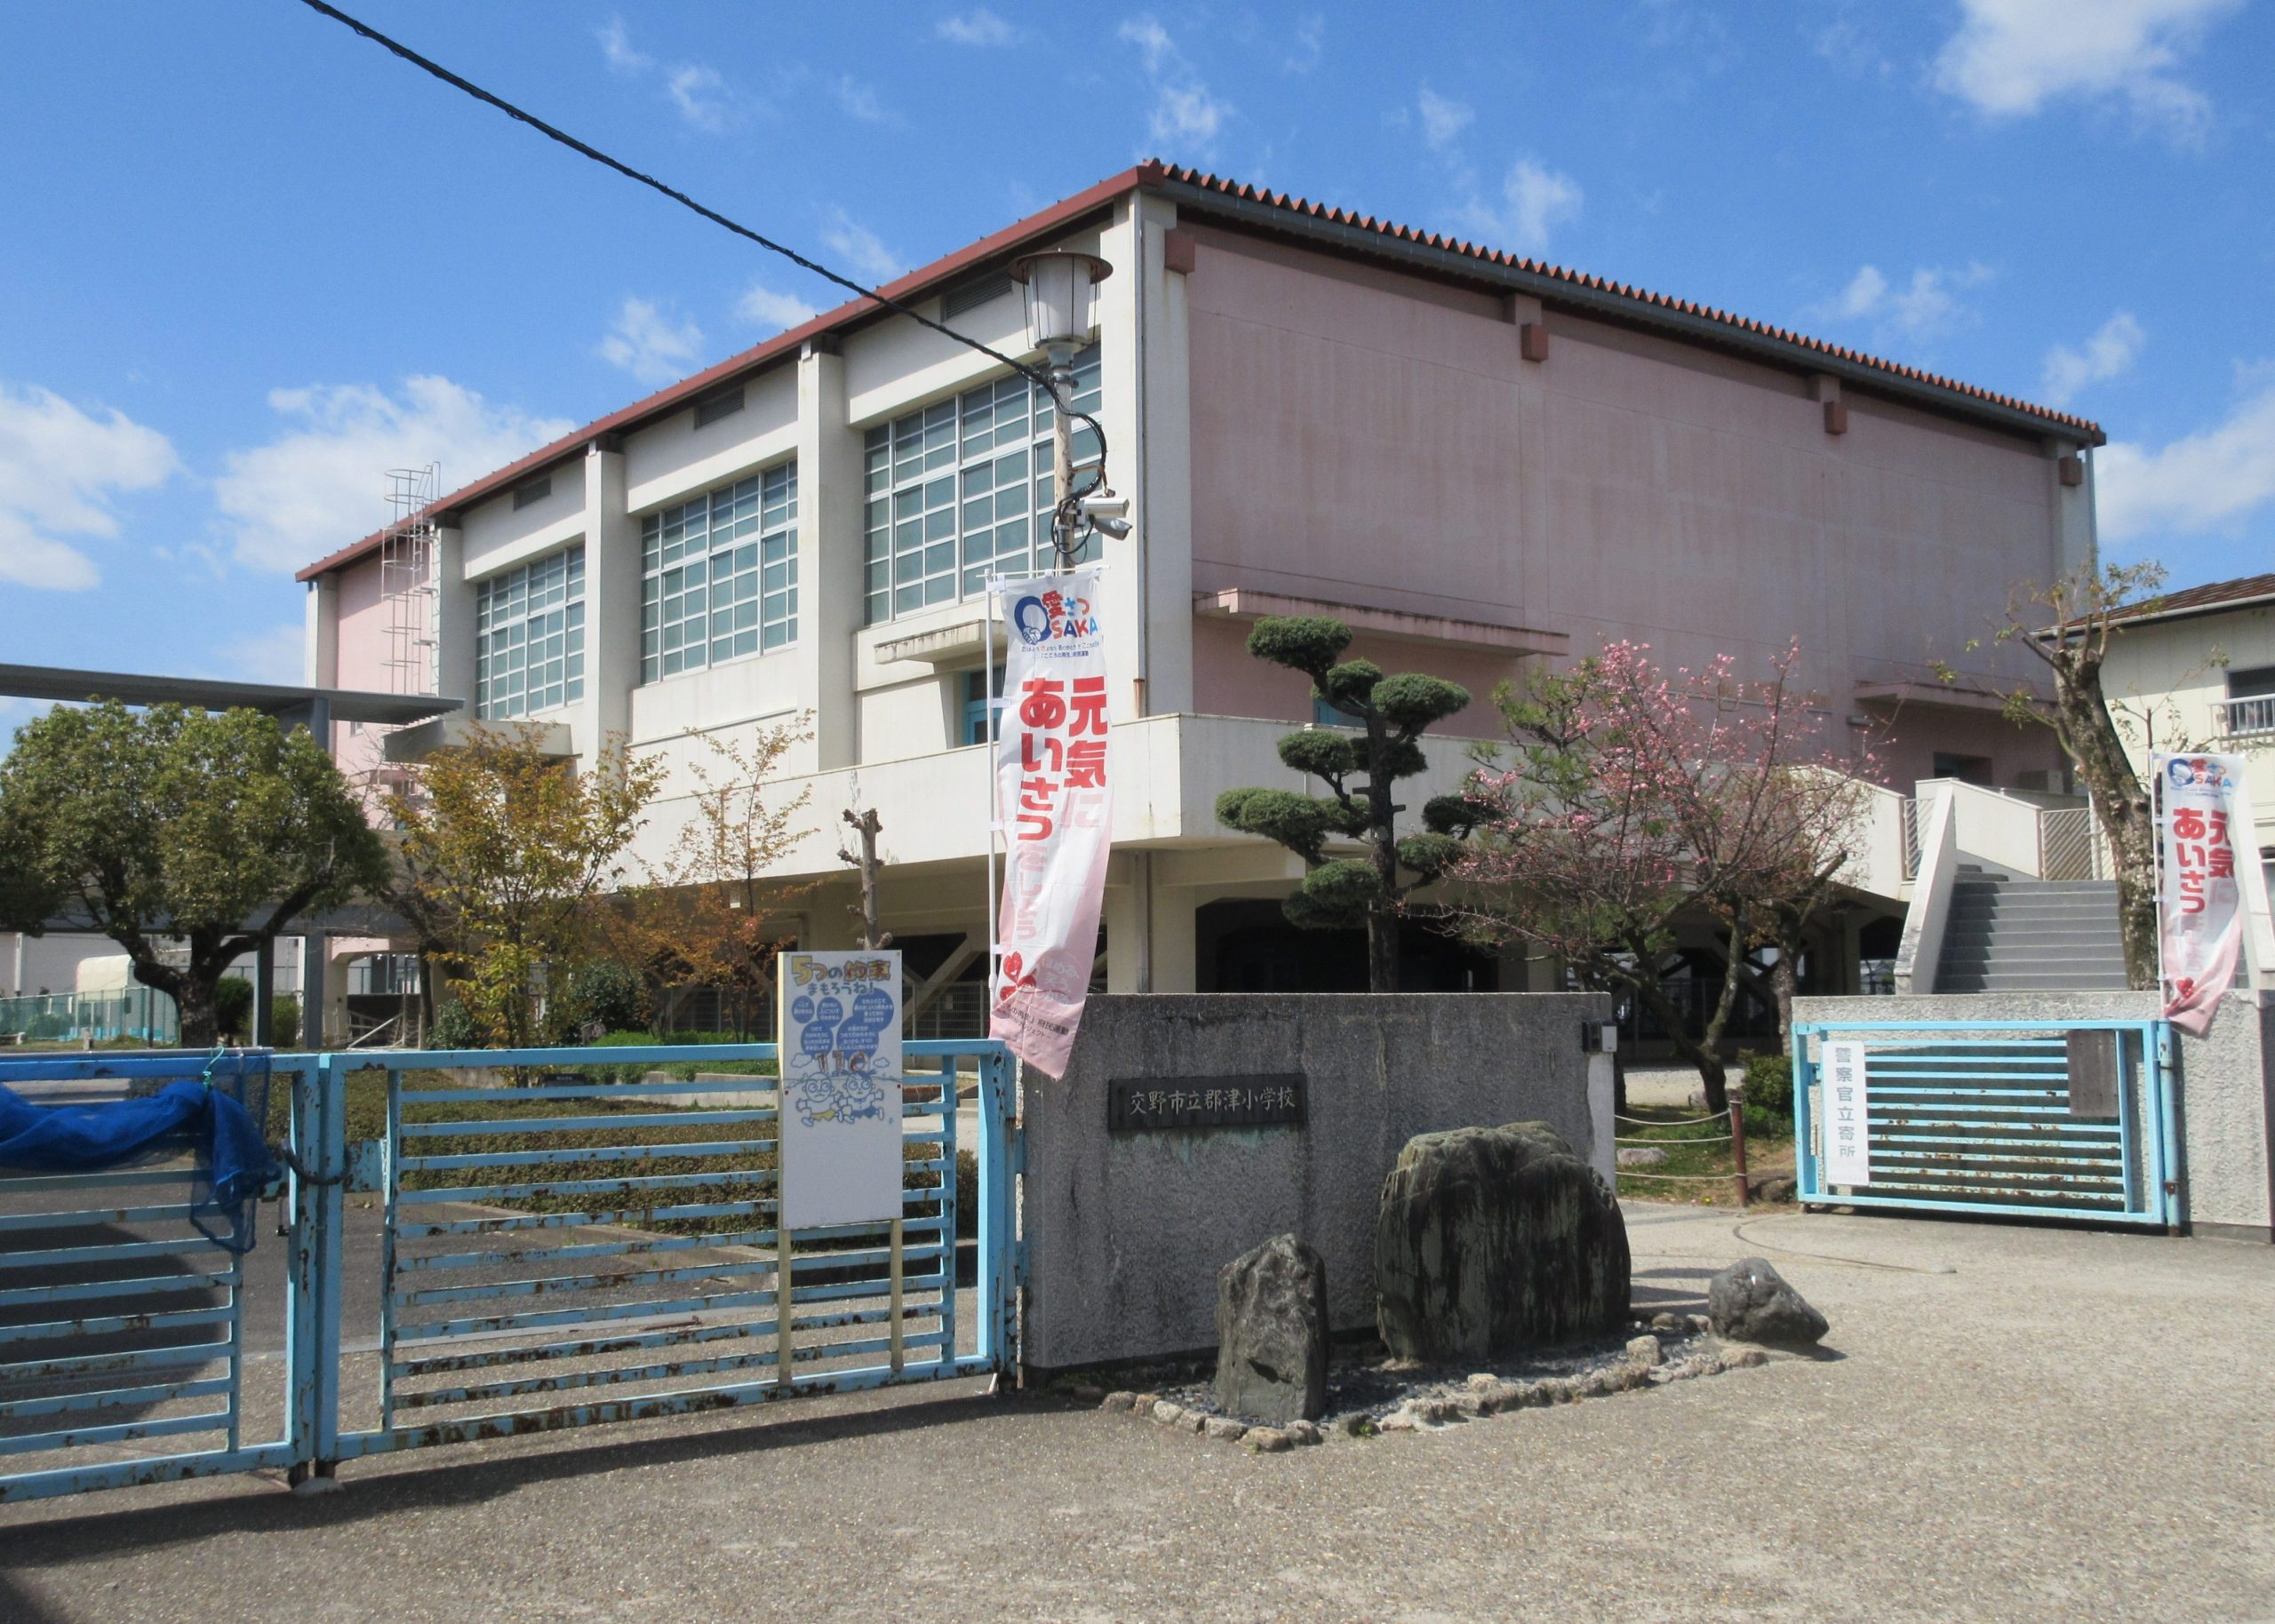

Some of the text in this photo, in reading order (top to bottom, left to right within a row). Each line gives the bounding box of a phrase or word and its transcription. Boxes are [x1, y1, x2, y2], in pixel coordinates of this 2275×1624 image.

[792, 955, 891, 986] 5つの約束
[1130, 1087, 1296, 1116] 交野市立郡津小学校
[1835, 1047, 1856, 1158] 警察官立寄所
